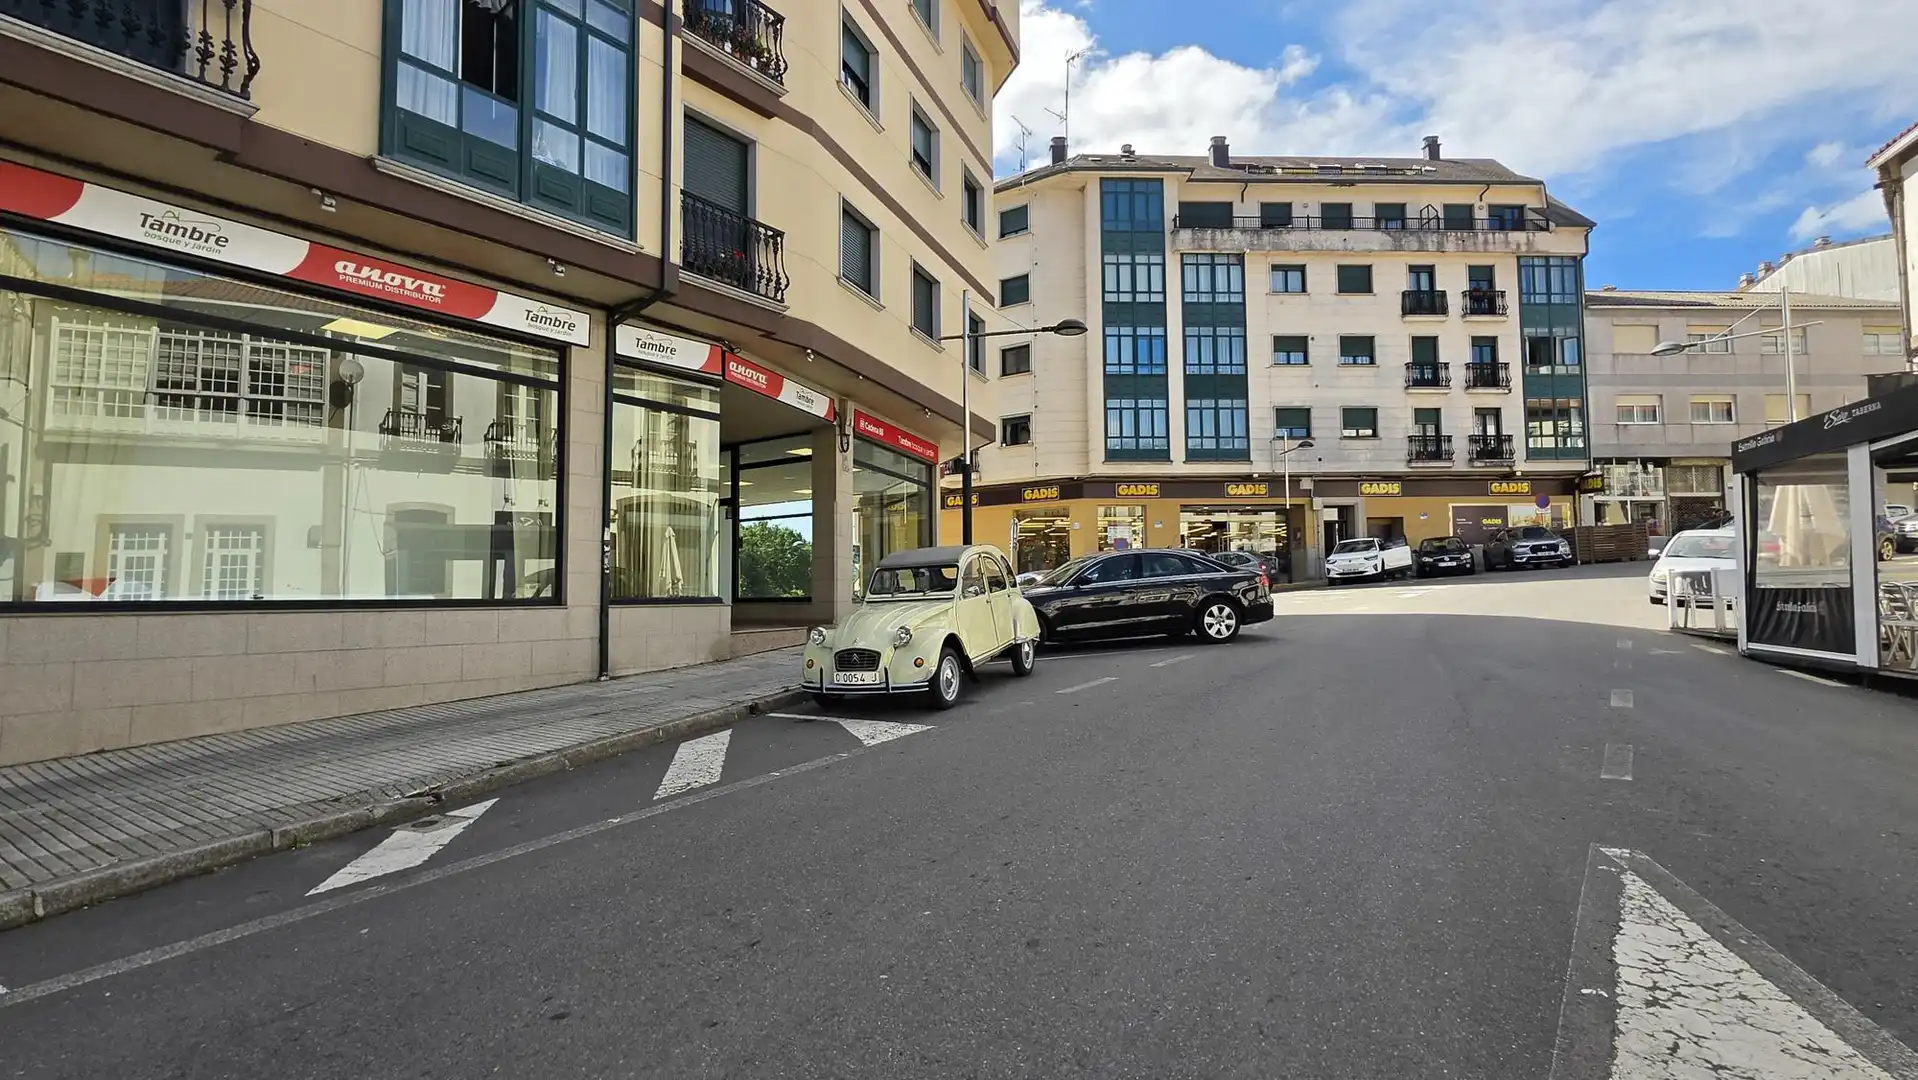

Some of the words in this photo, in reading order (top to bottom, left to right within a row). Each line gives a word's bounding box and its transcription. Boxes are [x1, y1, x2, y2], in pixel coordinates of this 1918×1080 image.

[140, 212, 230, 248] Tambre
[144, 231, 182, 246] bosque
[334, 261, 446, 298] anova
[339, 275, 383, 291] PREMIUM
[384, 285, 442, 305] DISTRIBUTOR
[525, 309, 577, 332] Tambre
[635, 337, 677, 356] Tambre
[729, 361, 768, 385] anova
[796, 390, 815, 406] Tambre
[1023, 488, 1058, 501] GADIS
[1118, 484, 1158, 496] GADIS
[1227, 484, 1267, 496] GADIS
[1360, 483, 1400, 495] GADIS
[1490, 482, 1529, 494] GADIS
[947, 495, 978, 507] GAS
[842, 673, 866, 683] 0054
[871, 672, 878, 683] J
